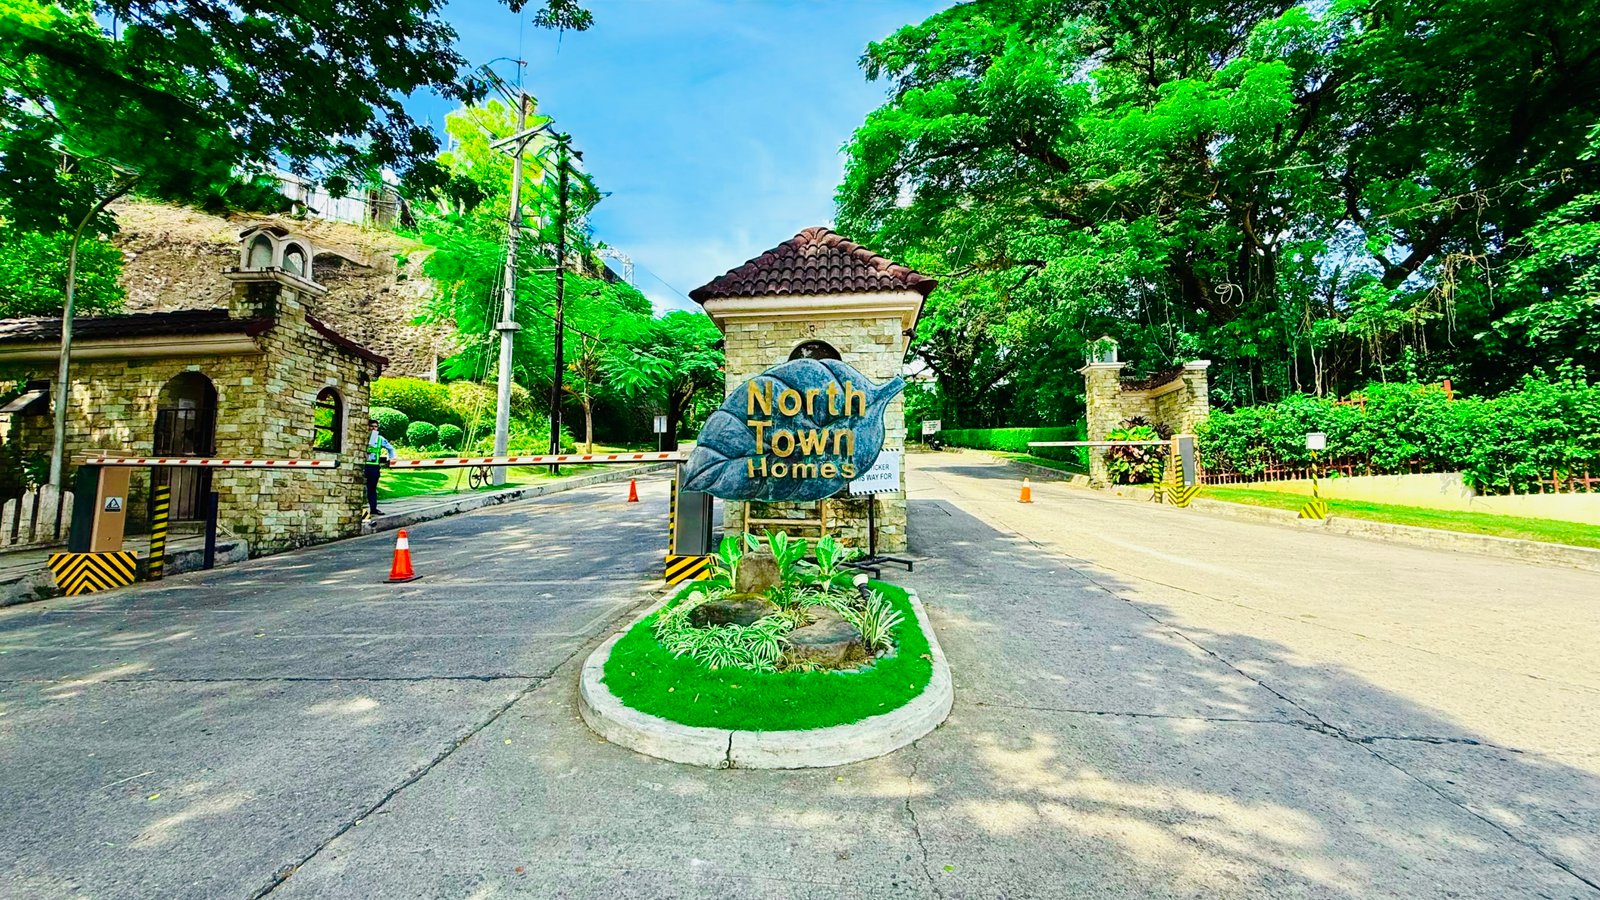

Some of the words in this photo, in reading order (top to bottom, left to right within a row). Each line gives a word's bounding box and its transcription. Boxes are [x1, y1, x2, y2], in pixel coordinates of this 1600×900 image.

[747, 380, 866, 416] North
[747, 420, 854, 457] Town
[747, 457, 856, 478] Homes
[880, 472, 892, 480] FOR
